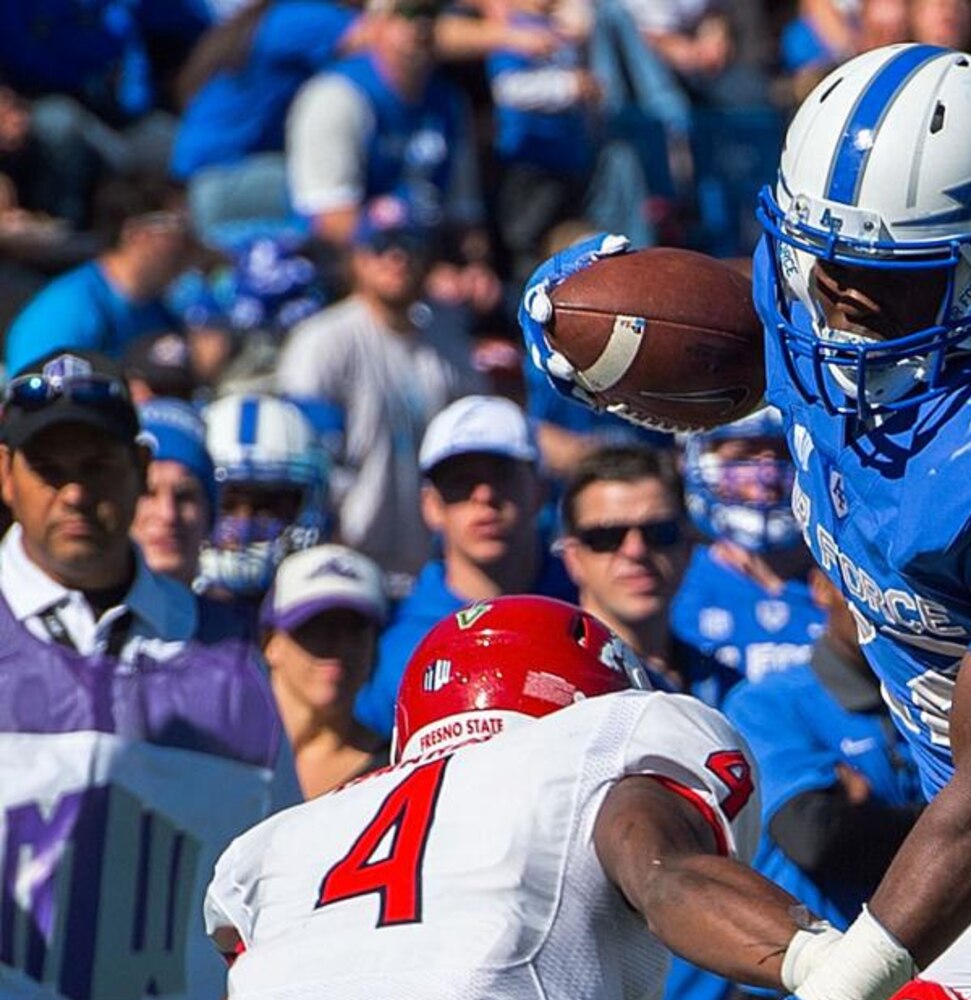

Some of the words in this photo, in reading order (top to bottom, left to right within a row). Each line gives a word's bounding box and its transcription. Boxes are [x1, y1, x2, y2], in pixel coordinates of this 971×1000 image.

[816, 522, 966, 638] FORCE
[420, 722, 462, 752] FRESNO
[467, 718, 503, 736] STATE
[704, 750, 755, 822] 4
[312, 752, 454, 929] 4
